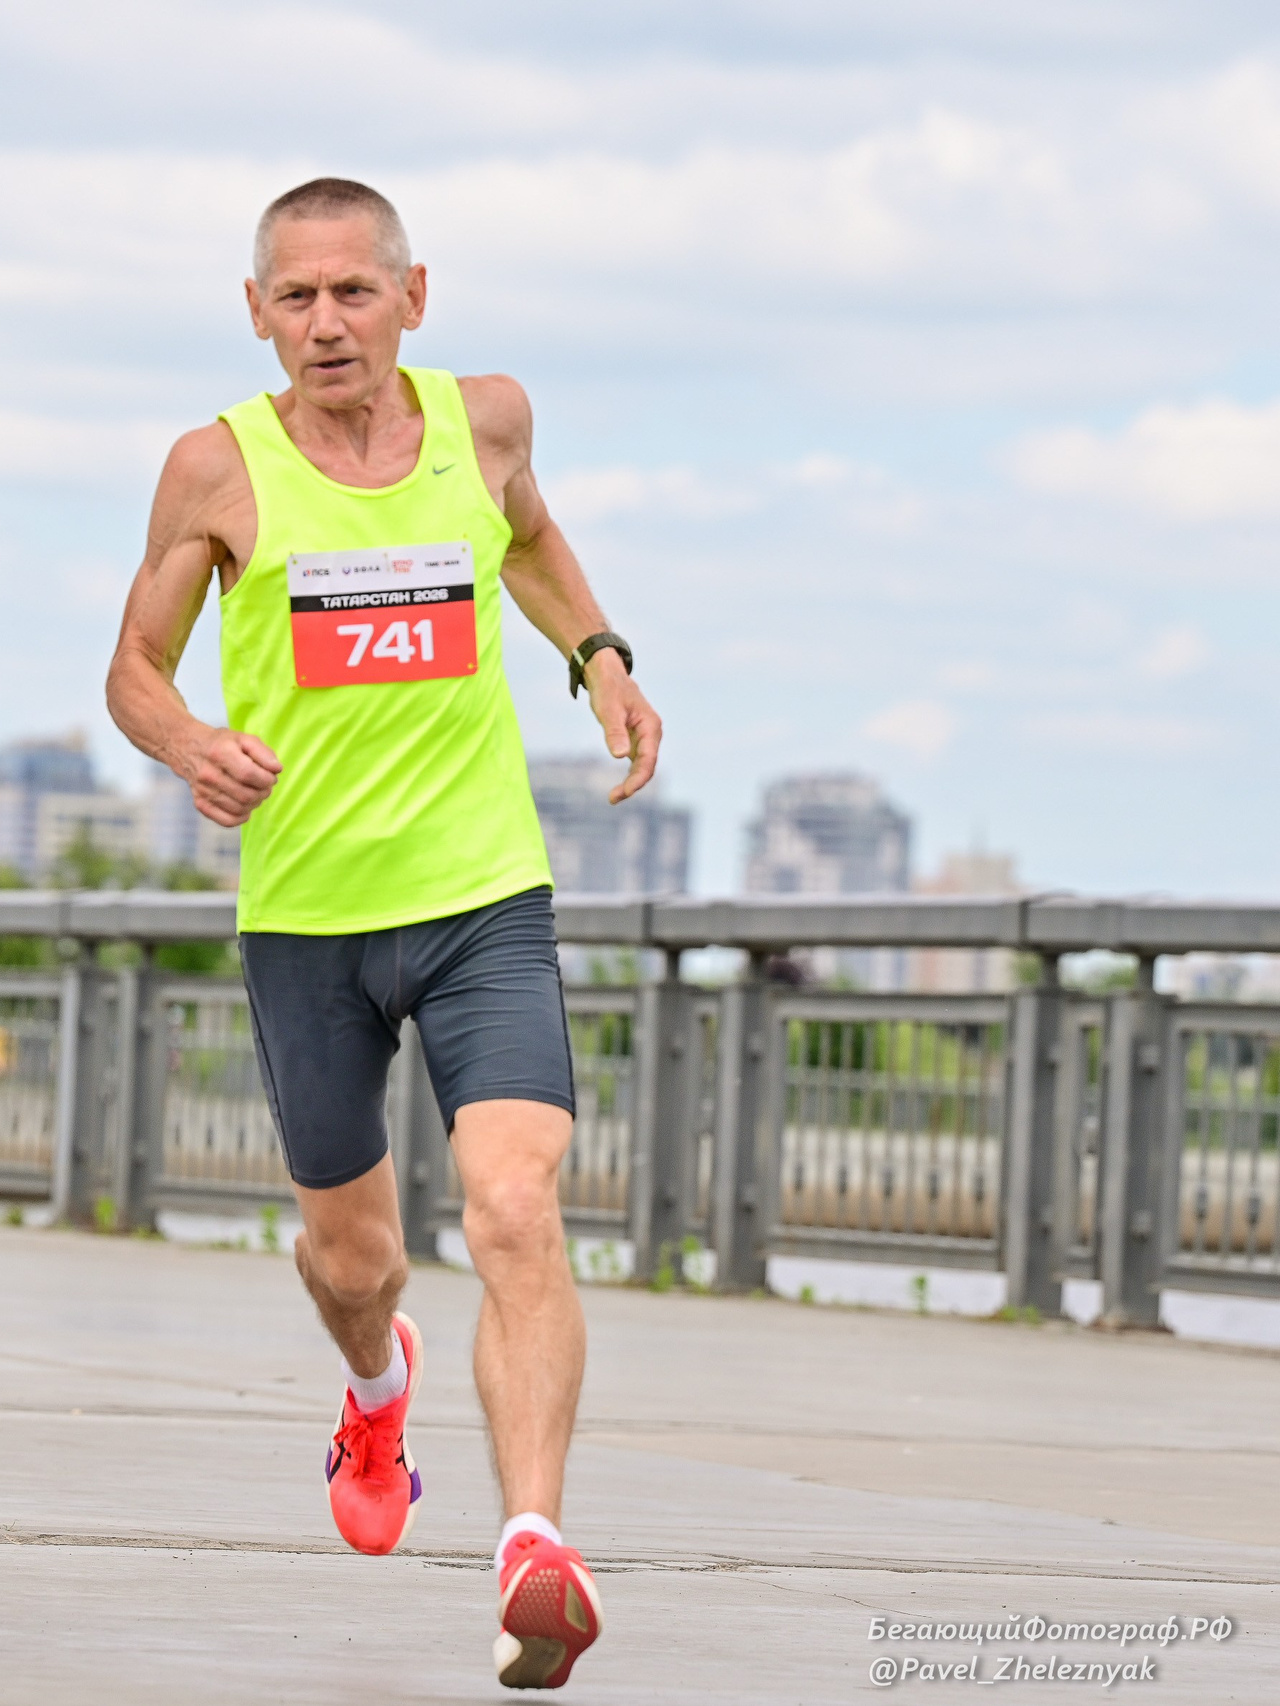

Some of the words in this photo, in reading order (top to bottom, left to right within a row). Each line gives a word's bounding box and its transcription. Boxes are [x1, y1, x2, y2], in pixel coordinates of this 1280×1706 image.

[320, 591, 411, 609] ТАТАРСТАН
[412, 588, 450, 602] 2026
[336, 618, 435, 667] 741
